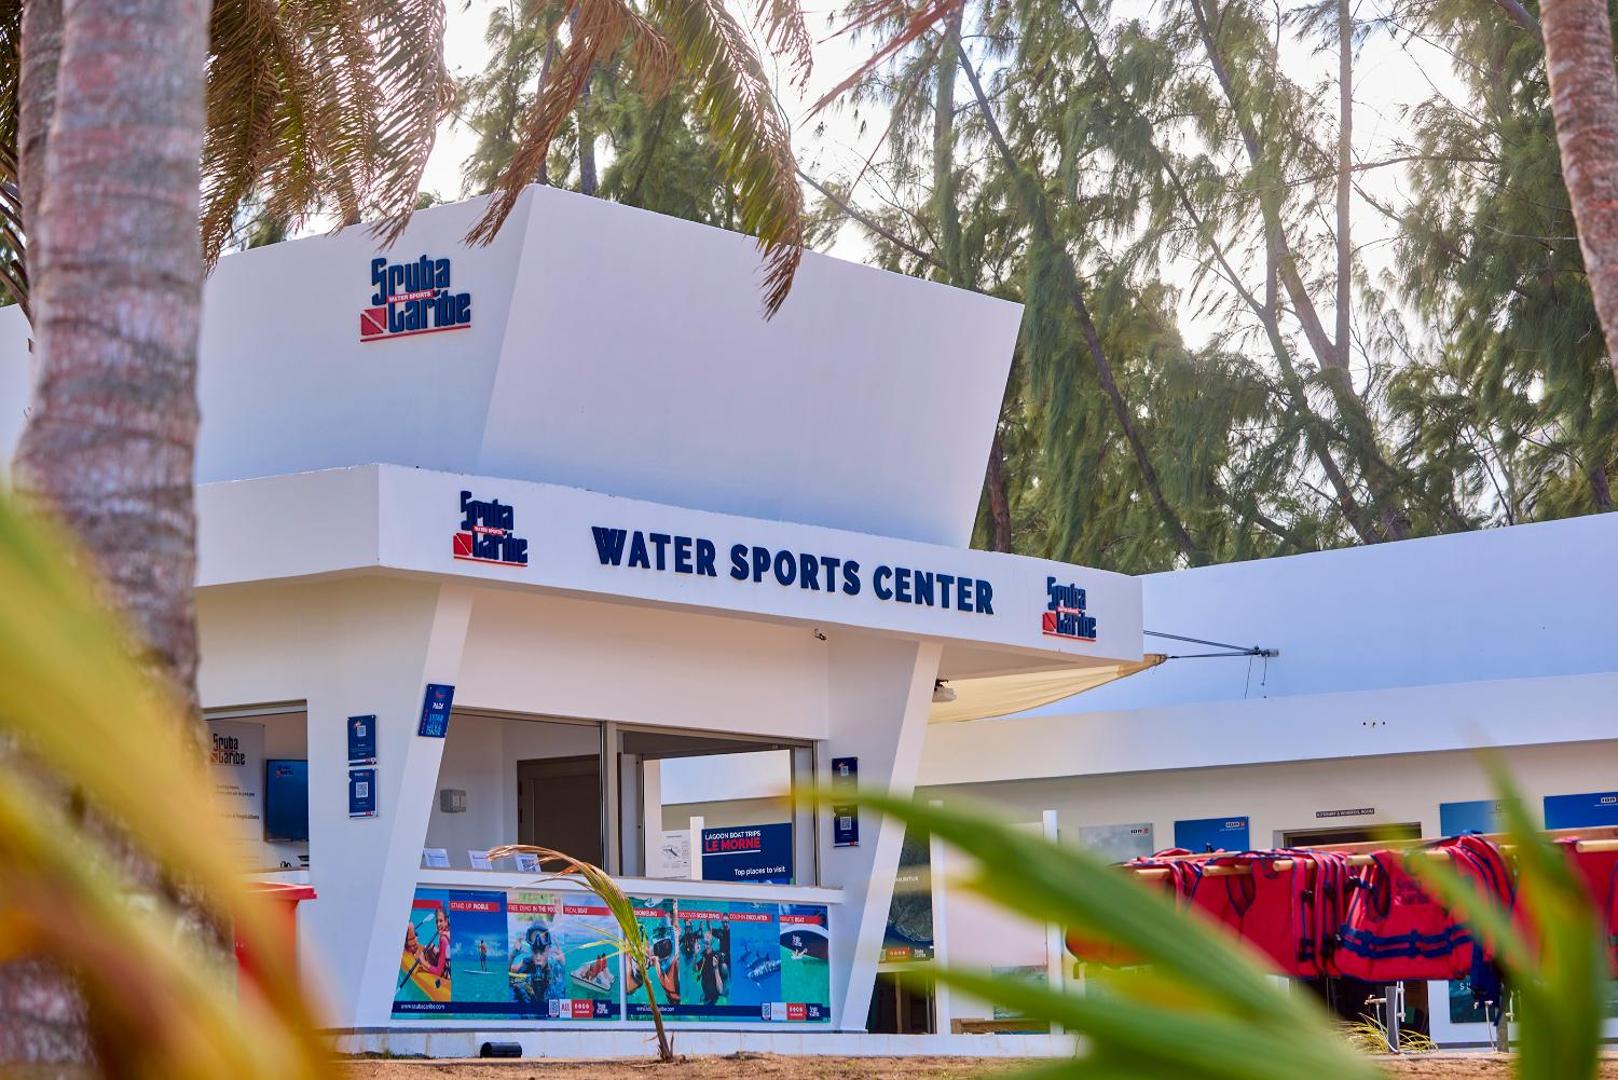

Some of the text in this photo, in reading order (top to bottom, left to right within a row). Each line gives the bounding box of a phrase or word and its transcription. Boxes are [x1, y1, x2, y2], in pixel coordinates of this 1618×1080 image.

[371, 254, 450, 306] Scuba
[389, 291, 431, 302] WATER SPORTS
[388, 289, 471, 333] Caribe
[460, 490, 514, 531] Scuba
[473, 532, 528, 563] Caribe
[591, 526, 994, 615] WATER SPORTS CENTER
[1047, 576, 1086, 610] Scuba
[1056, 611, 1097, 638] Caribe
[213, 733, 239, 751] Scuba
[218, 751, 246, 765] Caribe
[704, 830, 761, 841] LAGOON BOAT TRIPS
[704, 836, 761, 853] LE MORNE
[734, 865, 786, 877] Top places to visit
